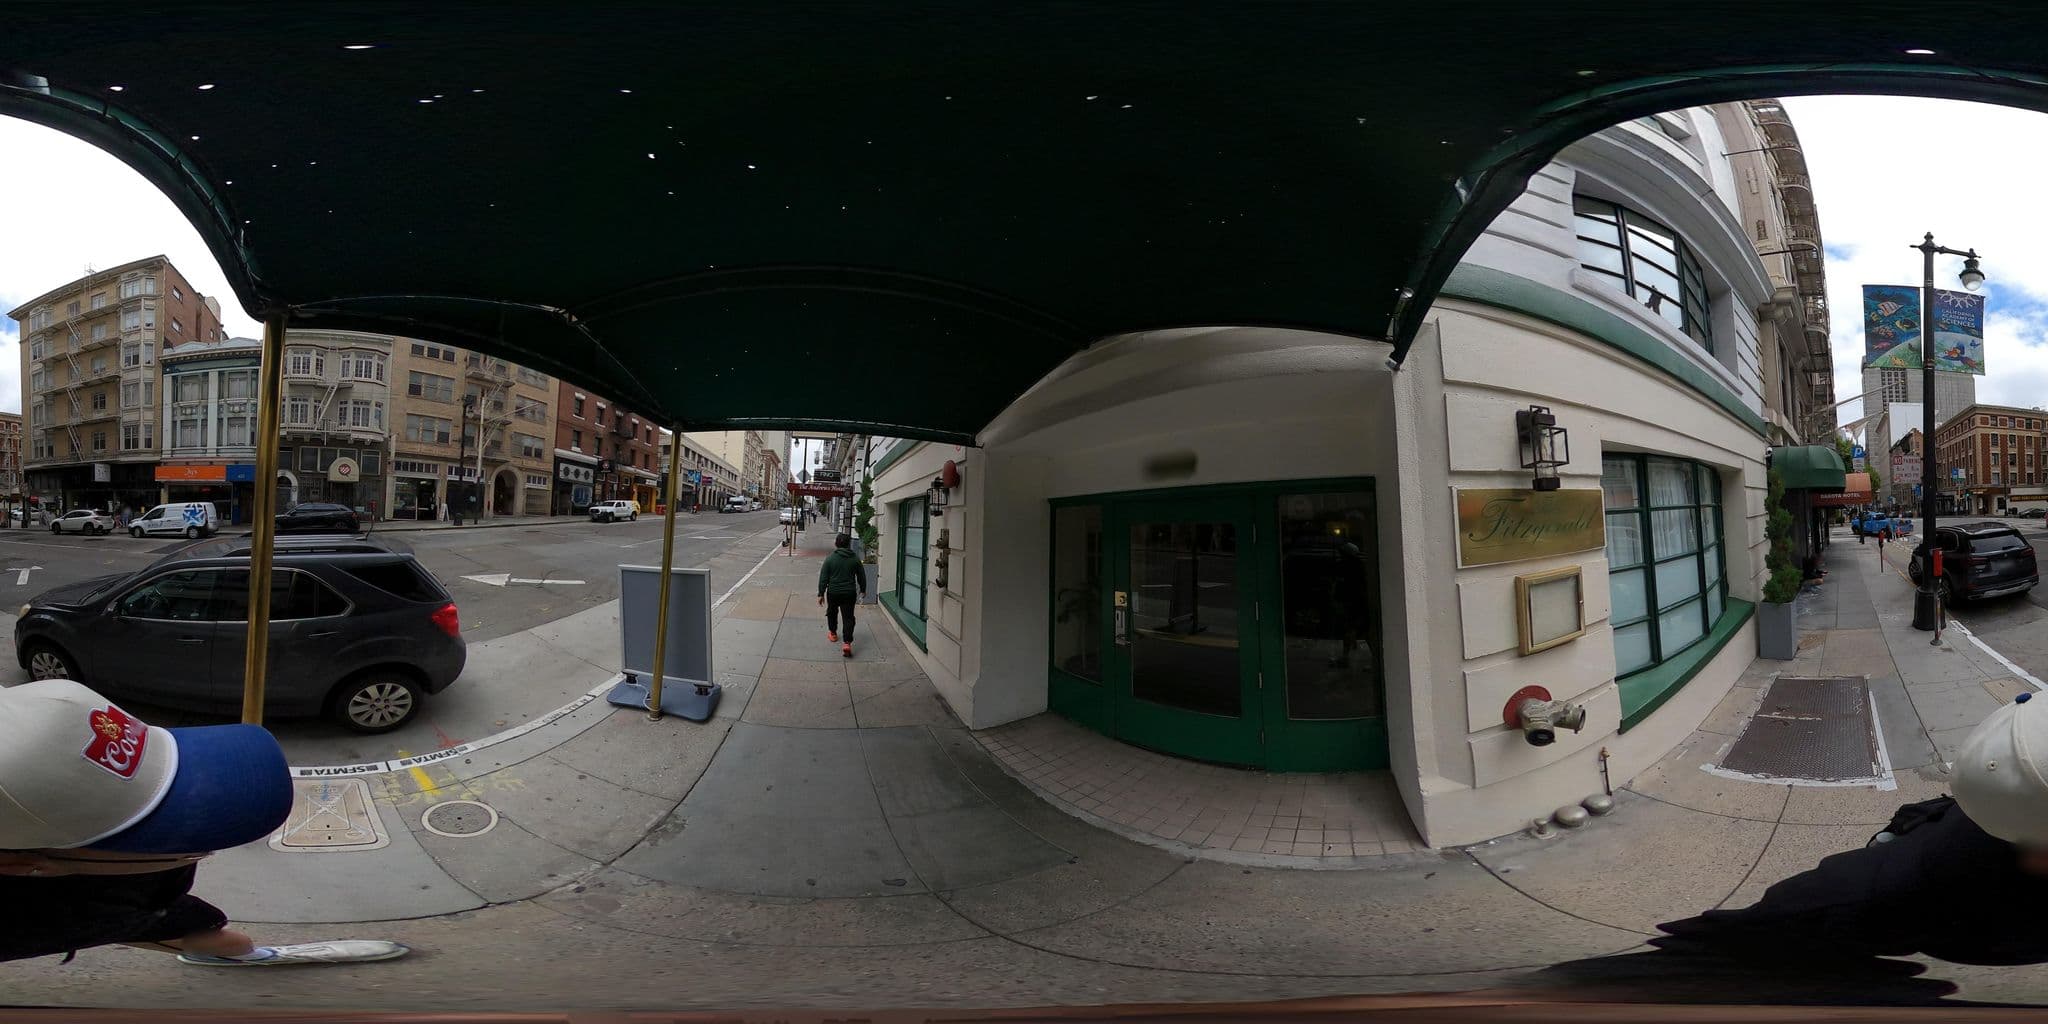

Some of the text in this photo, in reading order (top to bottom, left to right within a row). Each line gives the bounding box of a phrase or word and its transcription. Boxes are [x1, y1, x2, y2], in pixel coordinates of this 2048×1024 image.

[1941, 310, 1975, 318] CALIFORNIA
[1942, 313, 1966, 321] ACADEMY
[1941, 317, 1975, 328] SCIENCES
[1894, 456, 1902, 464] NO
[1468, 498, 1599, 545] Fitzgerald
[412, 748, 458, 764] SFMTA
[314, 766, 365, 775] SFMTA
